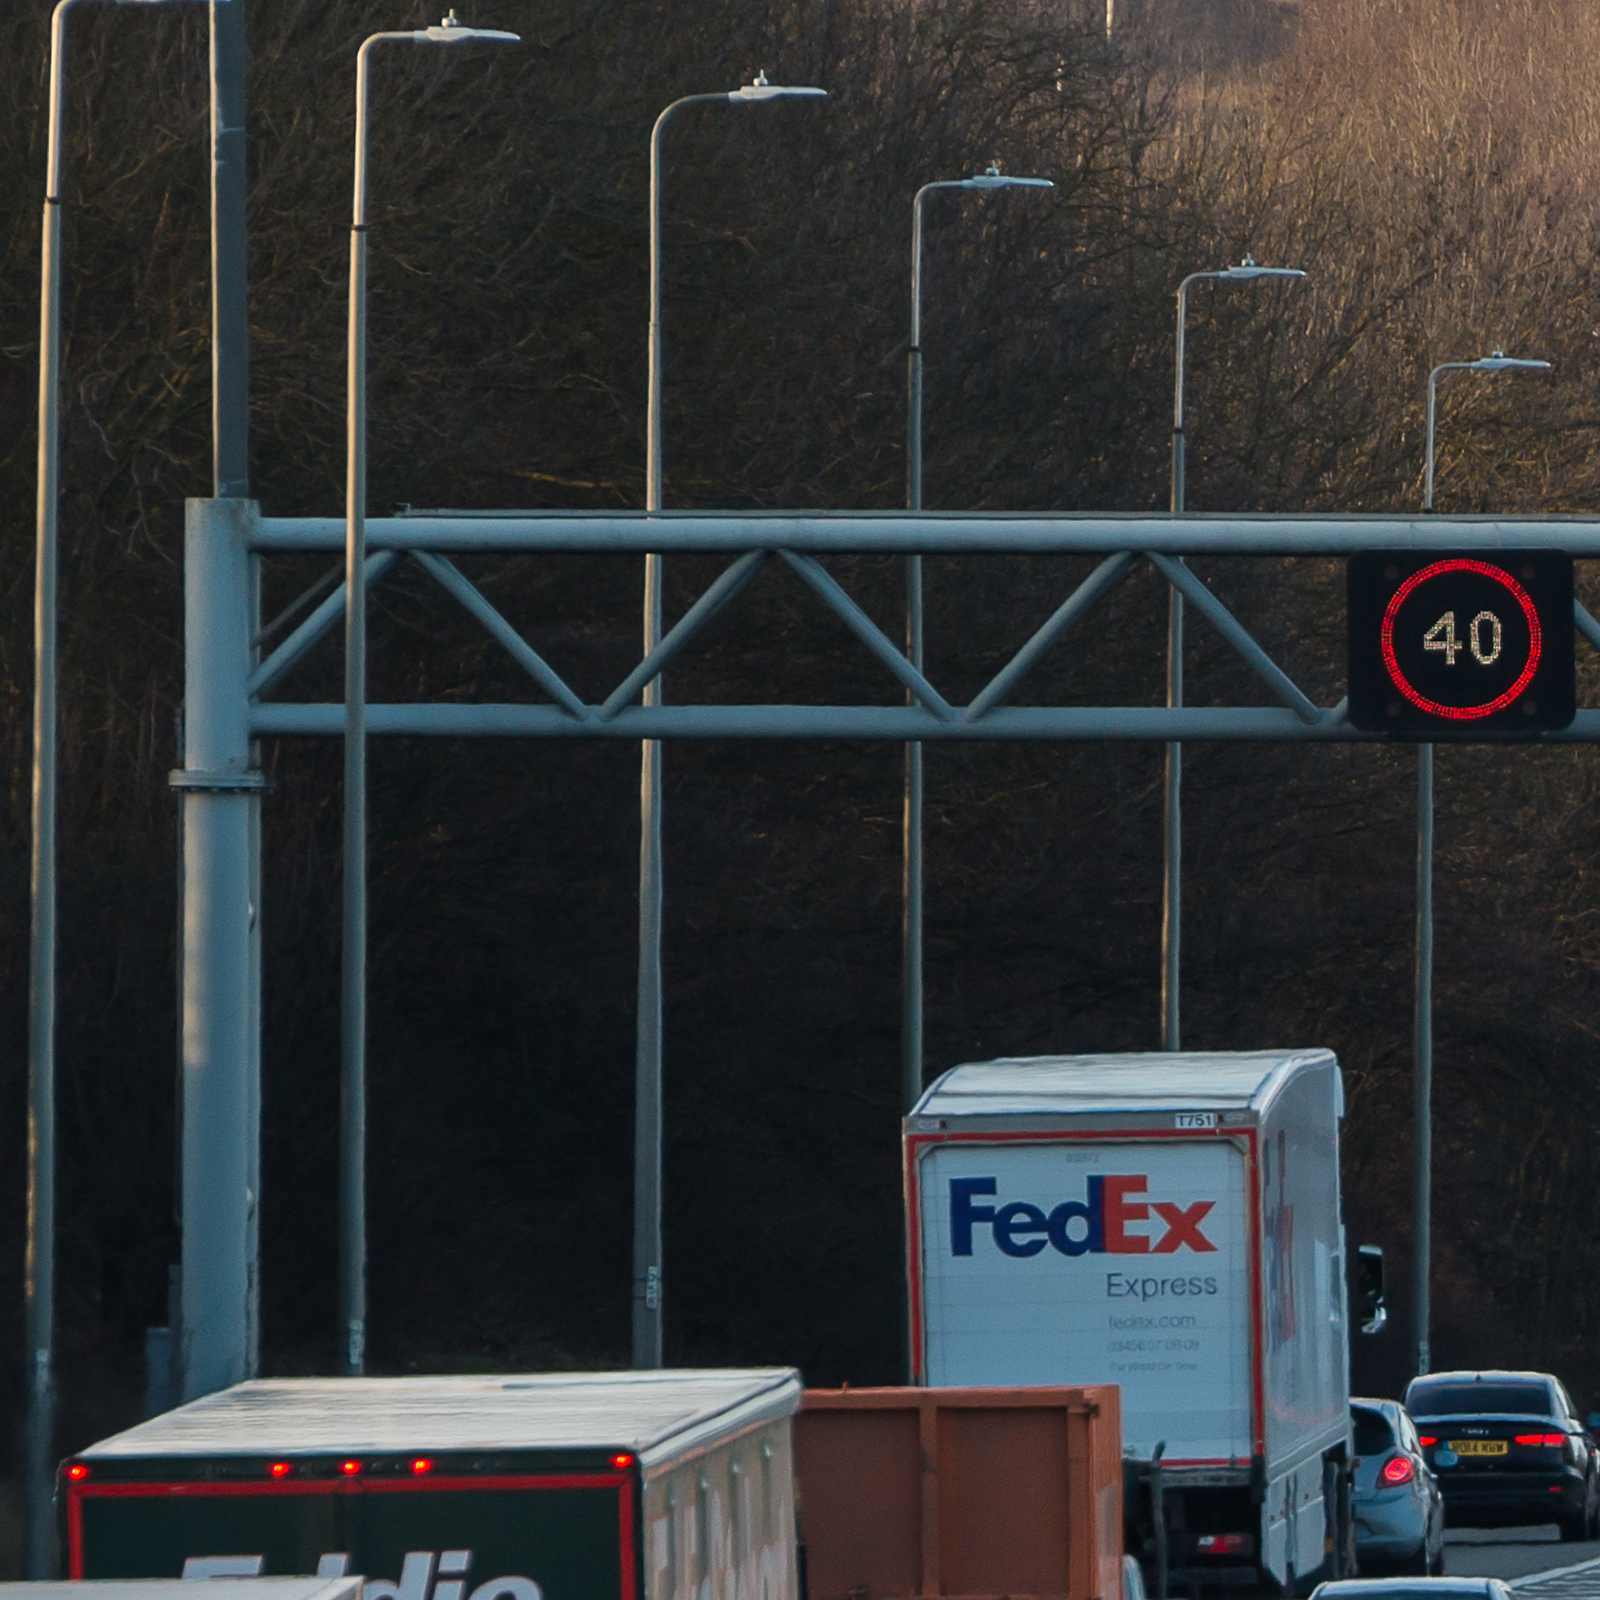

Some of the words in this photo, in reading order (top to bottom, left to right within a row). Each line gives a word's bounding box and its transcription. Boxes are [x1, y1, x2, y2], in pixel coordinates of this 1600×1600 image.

[1423, 610, 1502, 665] 40
[1178, 1113, 1215, 1128] T751
[949, 1174, 1218, 1258] FedEx
[1106, 1272, 1218, 1302] Express
